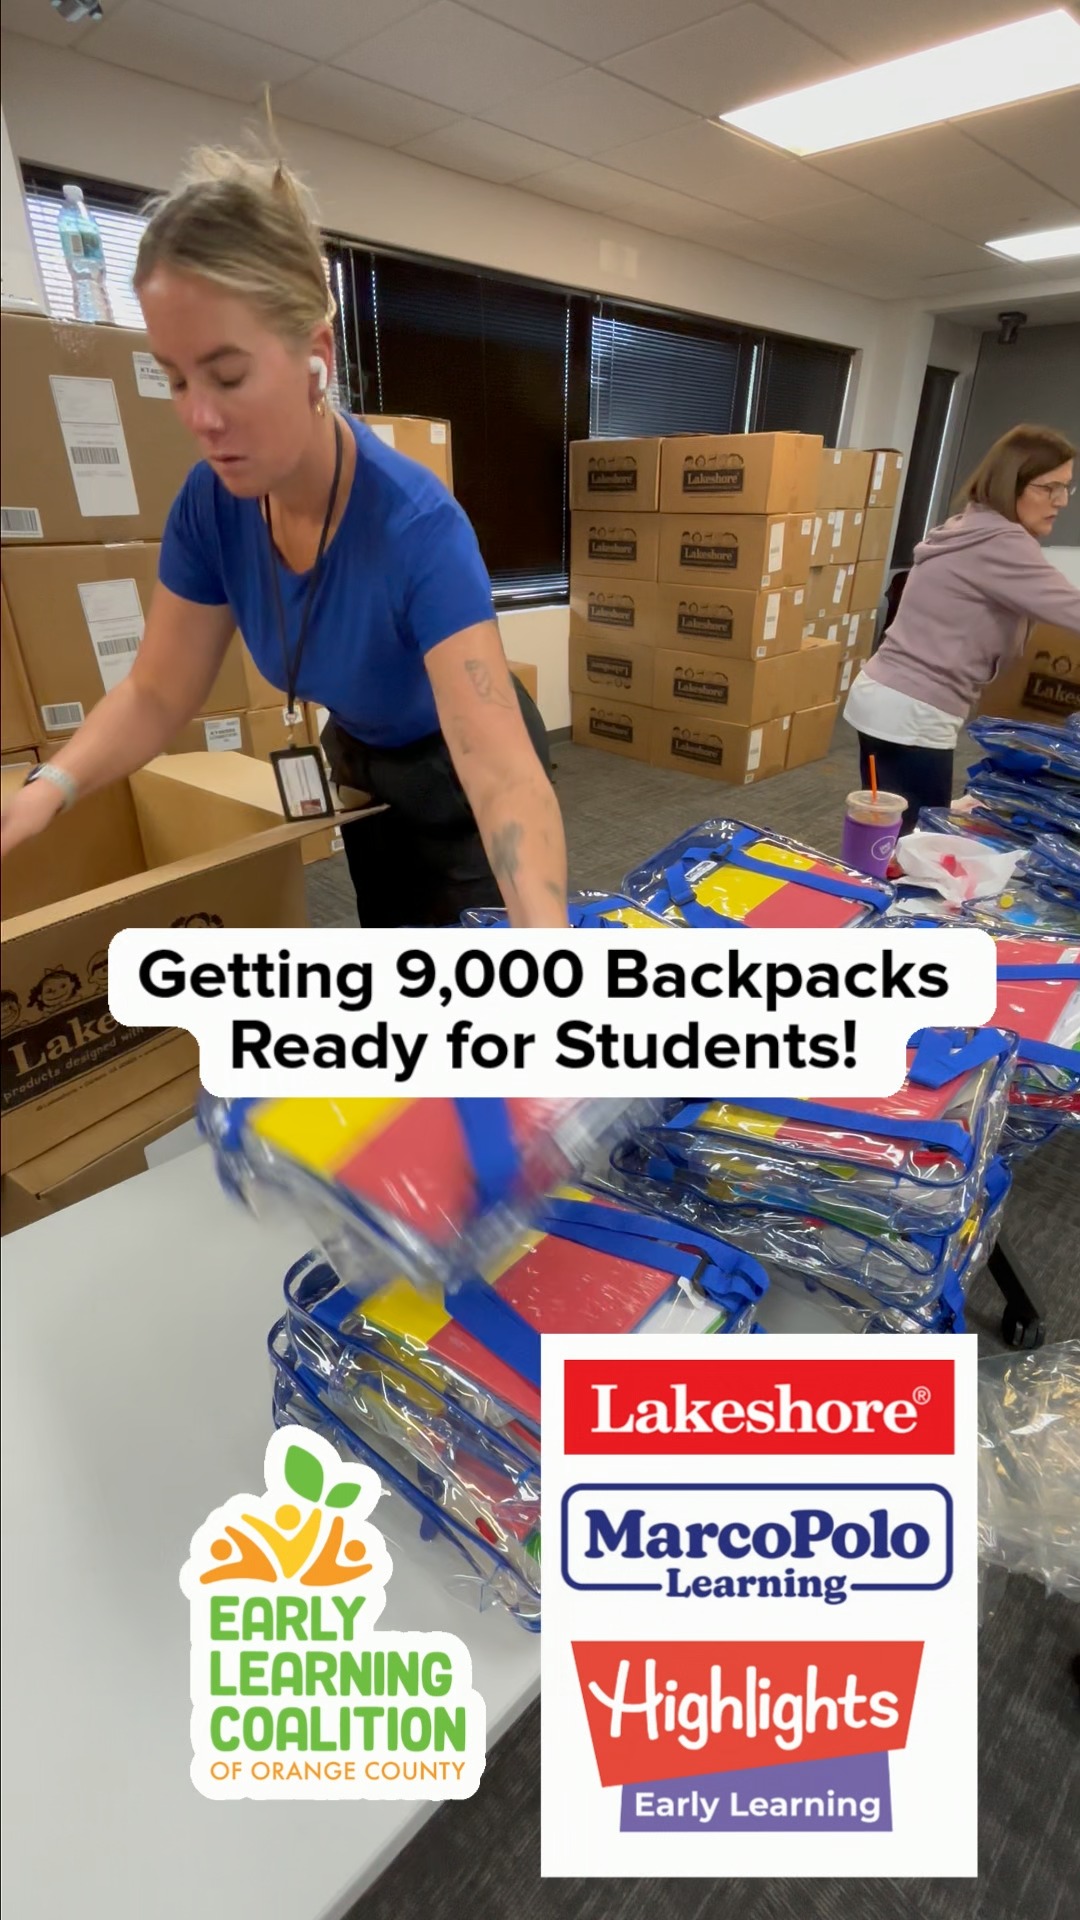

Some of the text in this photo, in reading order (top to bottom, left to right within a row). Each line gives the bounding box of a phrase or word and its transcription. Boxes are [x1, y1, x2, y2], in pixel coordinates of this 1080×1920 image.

[687, 472, 738, 485] Lakeshore
[685, 547, 733, 561] Lakeshore
[681, 616, 728, 632] Lakeshore
[3, 1068, 61, 1103] products
[65, 1038, 117, 1070] designed
